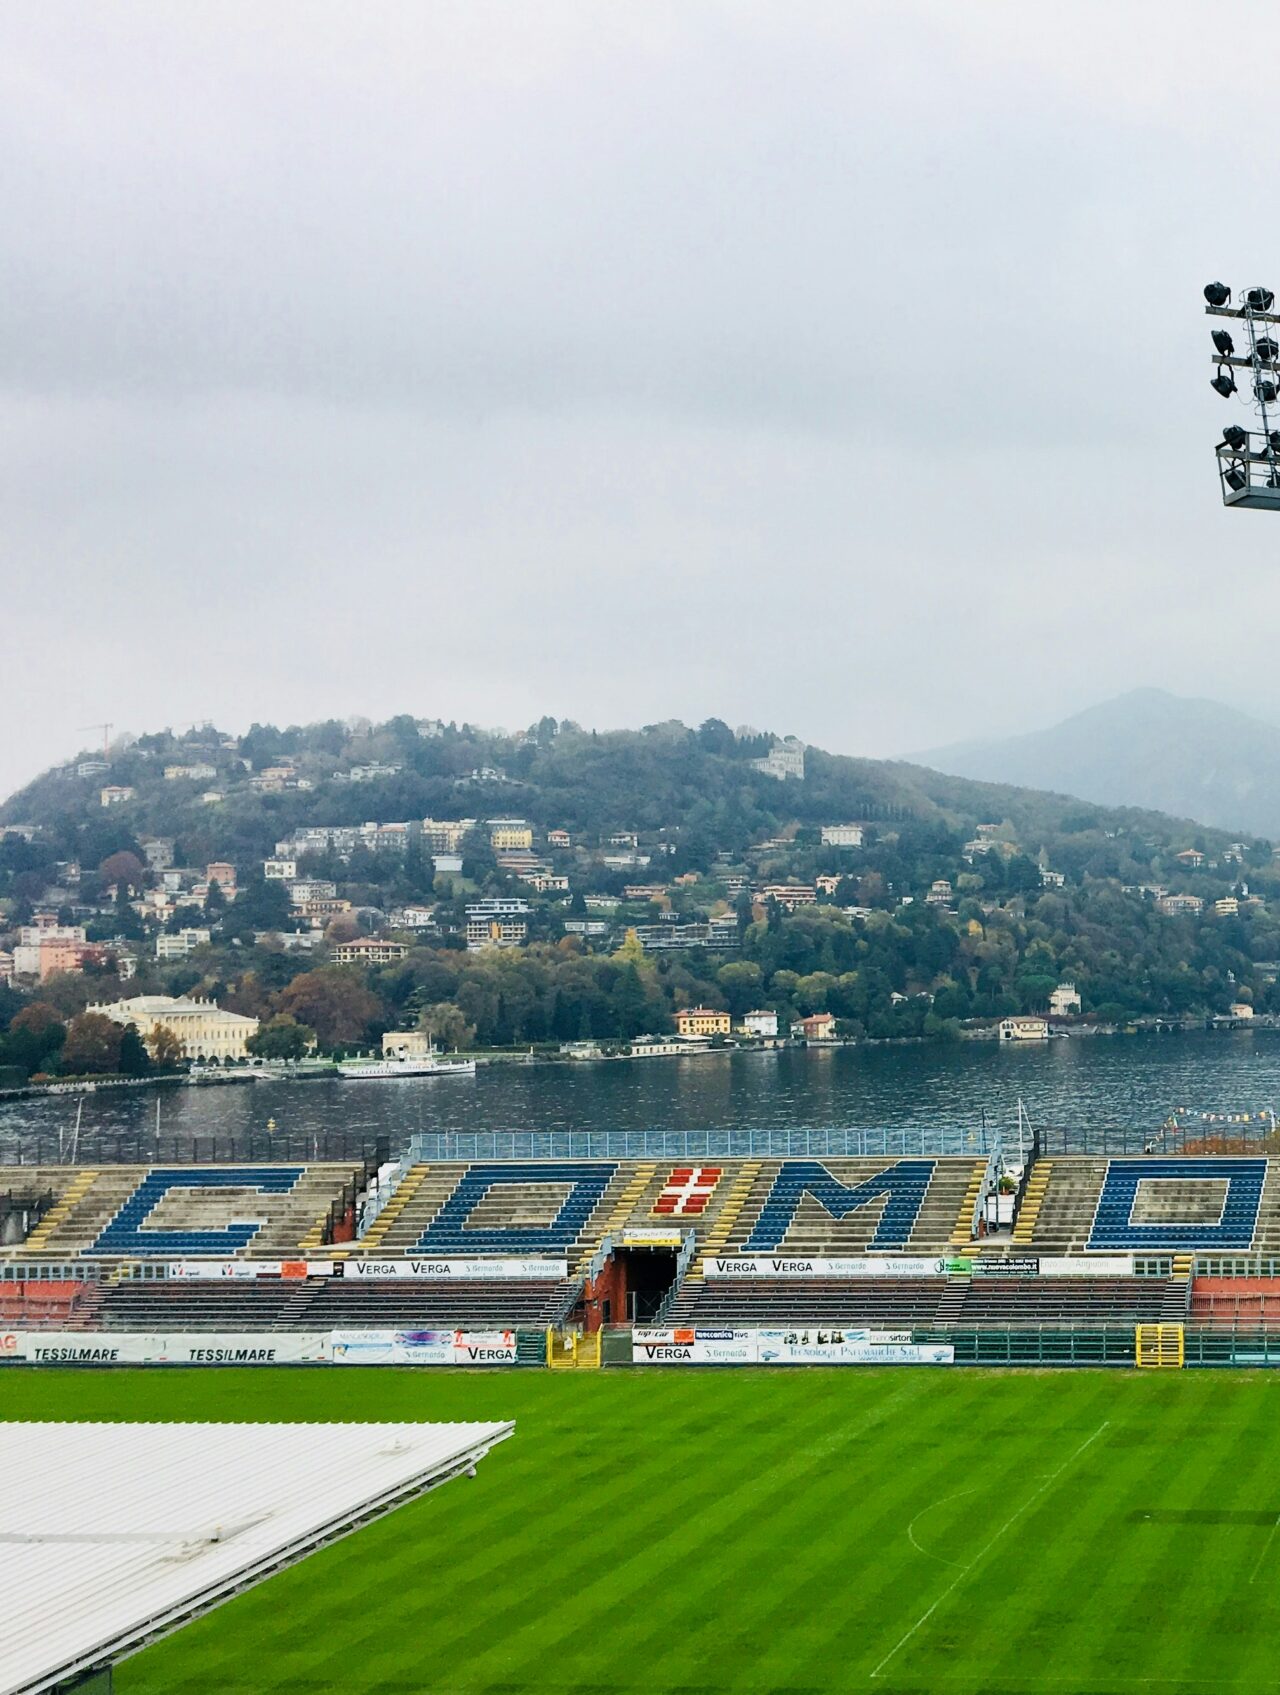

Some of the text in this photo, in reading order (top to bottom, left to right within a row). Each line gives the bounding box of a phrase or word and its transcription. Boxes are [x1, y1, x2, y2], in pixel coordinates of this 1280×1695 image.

[357, 1262, 397, 1275] VERGA
[411, 1262, 451, 1274] VERGA
[716, 1260, 757, 1272] VERGA
[772, 1259, 813, 1272] VERGA
[35, 1348, 120, 1361] TESSILMARE
[189, 1348, 276, 1361] TESSILMARE
[468, 1347, 513, 1360] VERGA
[645, 1345, 691, 1359] VERGA
